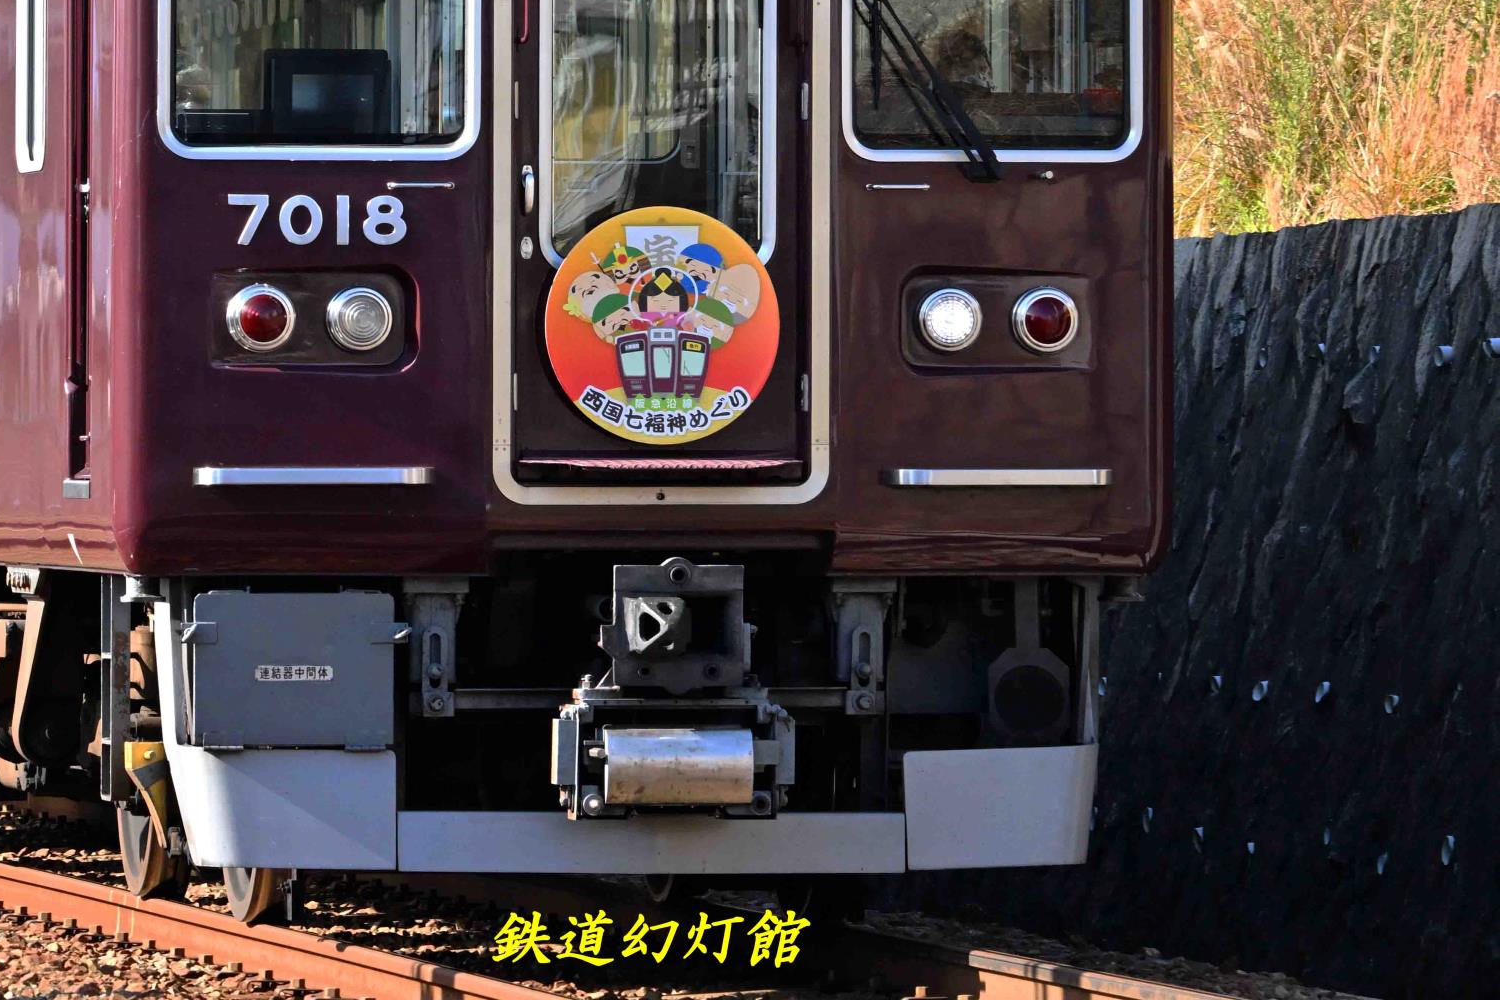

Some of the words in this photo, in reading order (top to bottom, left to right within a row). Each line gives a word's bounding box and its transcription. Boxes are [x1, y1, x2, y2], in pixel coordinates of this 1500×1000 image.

[227, 193, 407, 246] 7018
[579, 388, 749, 434] 西国七福神めぐり
[259, 666, 328, 679] 連結器中間体
